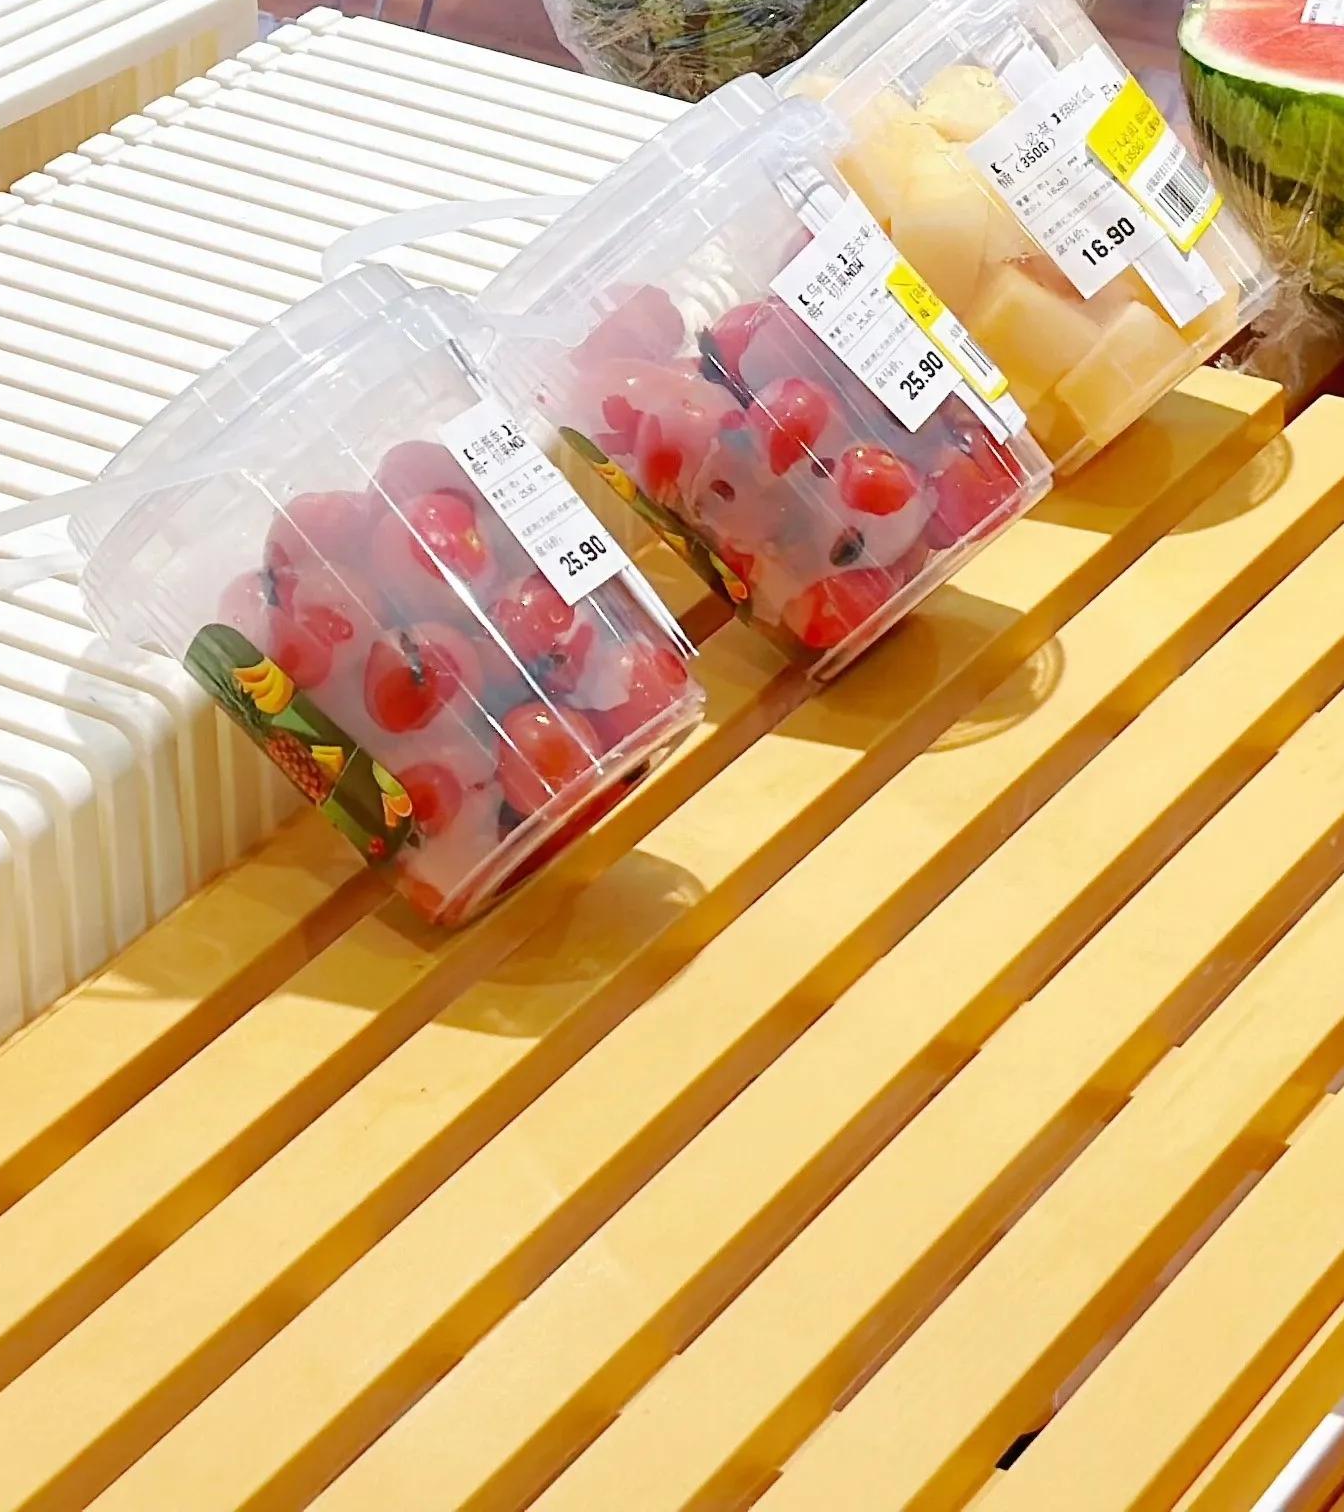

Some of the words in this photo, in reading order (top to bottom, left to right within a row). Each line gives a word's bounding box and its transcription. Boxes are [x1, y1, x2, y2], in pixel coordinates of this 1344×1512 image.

[1081, 216, 1136, 266] 16.90
[899, 350, 945, 401] 25.90
[559, 534, 608, 577] 25.90
